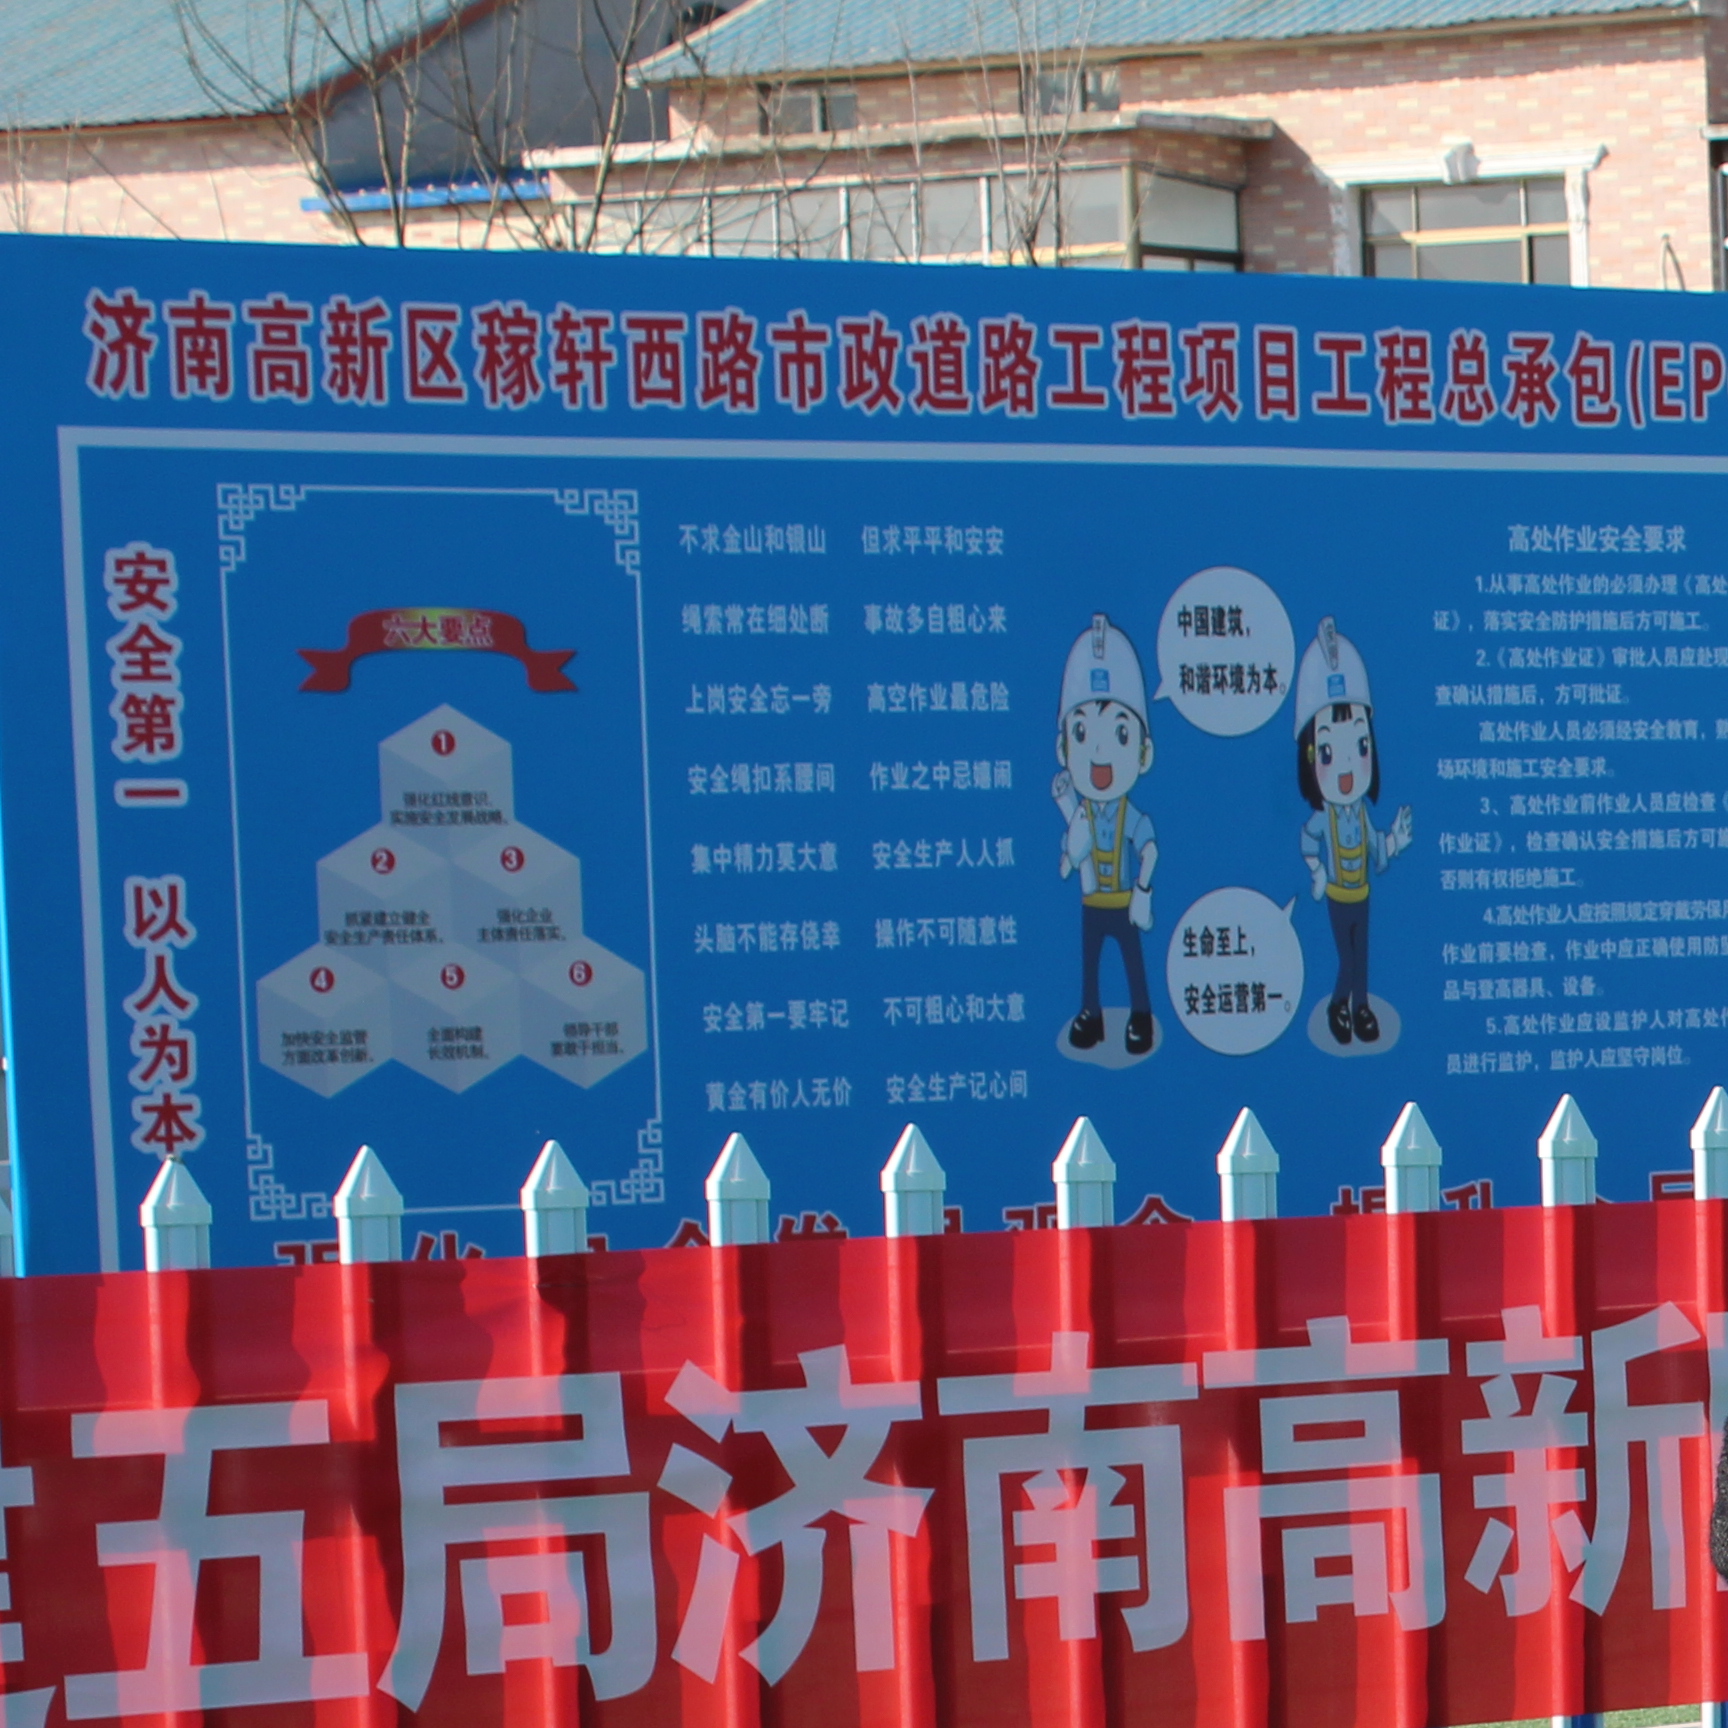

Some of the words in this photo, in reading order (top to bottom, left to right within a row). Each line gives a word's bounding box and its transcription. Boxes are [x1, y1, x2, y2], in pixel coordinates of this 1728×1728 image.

[678, 523, 826, 554] 不求金山和银山
[860, 524, 1004, 555] 但求平平和安安
[1508, 524, 1686, 553] 高处作业安全要求
[382, 614, 495, 648] 六大要点
[681, 604, 829, 634] 绳索常在细处断
[863, 603, 1007, 634] 事故多自粗心来
[1177, 604, 1251, 637] 中国建筑，
[106, 543, 186, 804] 安全第一
[1178, 662, 1286, 696] 和谐环境为本。
[684, 682, 832, 714] 上岗安全忘一旁
[867, 681, 1009, 712] 高空作业最危险
[688, 762, 835, 794] 安全绳扣系腰间
[869, 759, 1012, 791] 作业之中忌嬉闹
[690, 841, 838, 874] 集中精力莫大意
[871, 837, 1015, 870] 安全生产人人抓
[694, 920, 840, 953] 头脑不能存侥幸
[874, 915, 1017, 948] 操作不可随意性
[702, 998, 850, 1033] 安全第一要牢记
[883, 992, 1026, 1026] 不可粗心和大意
[1183, 981, 1292, 1017] 安全运营第一。
[125, 876, 204, 1158] 以人为本
[705, 1076, 852, 1112] 黄金有价人无价
[885, 1069, 1028, 1104] 安全生产记心间
